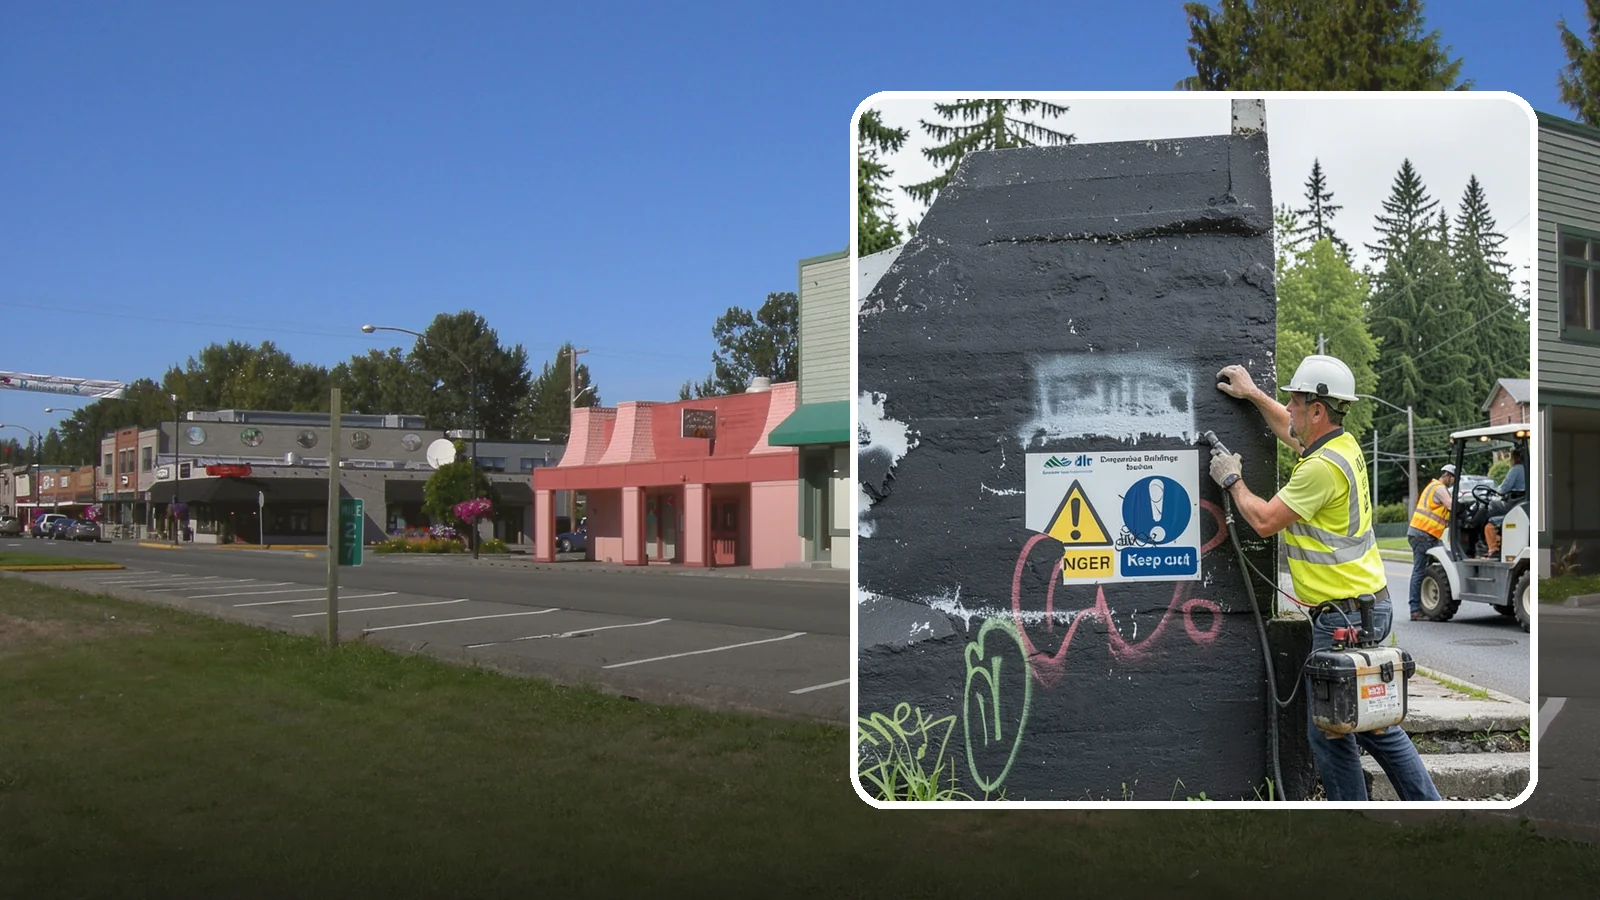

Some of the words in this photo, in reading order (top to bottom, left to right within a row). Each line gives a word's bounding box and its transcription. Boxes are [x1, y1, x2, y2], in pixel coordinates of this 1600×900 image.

[341, 505, 361, 516] MILE
[344, 522, 356, 538] 2
[344, 543, 356, 559] 7
[1127, 553, 1161, 569] Keep
